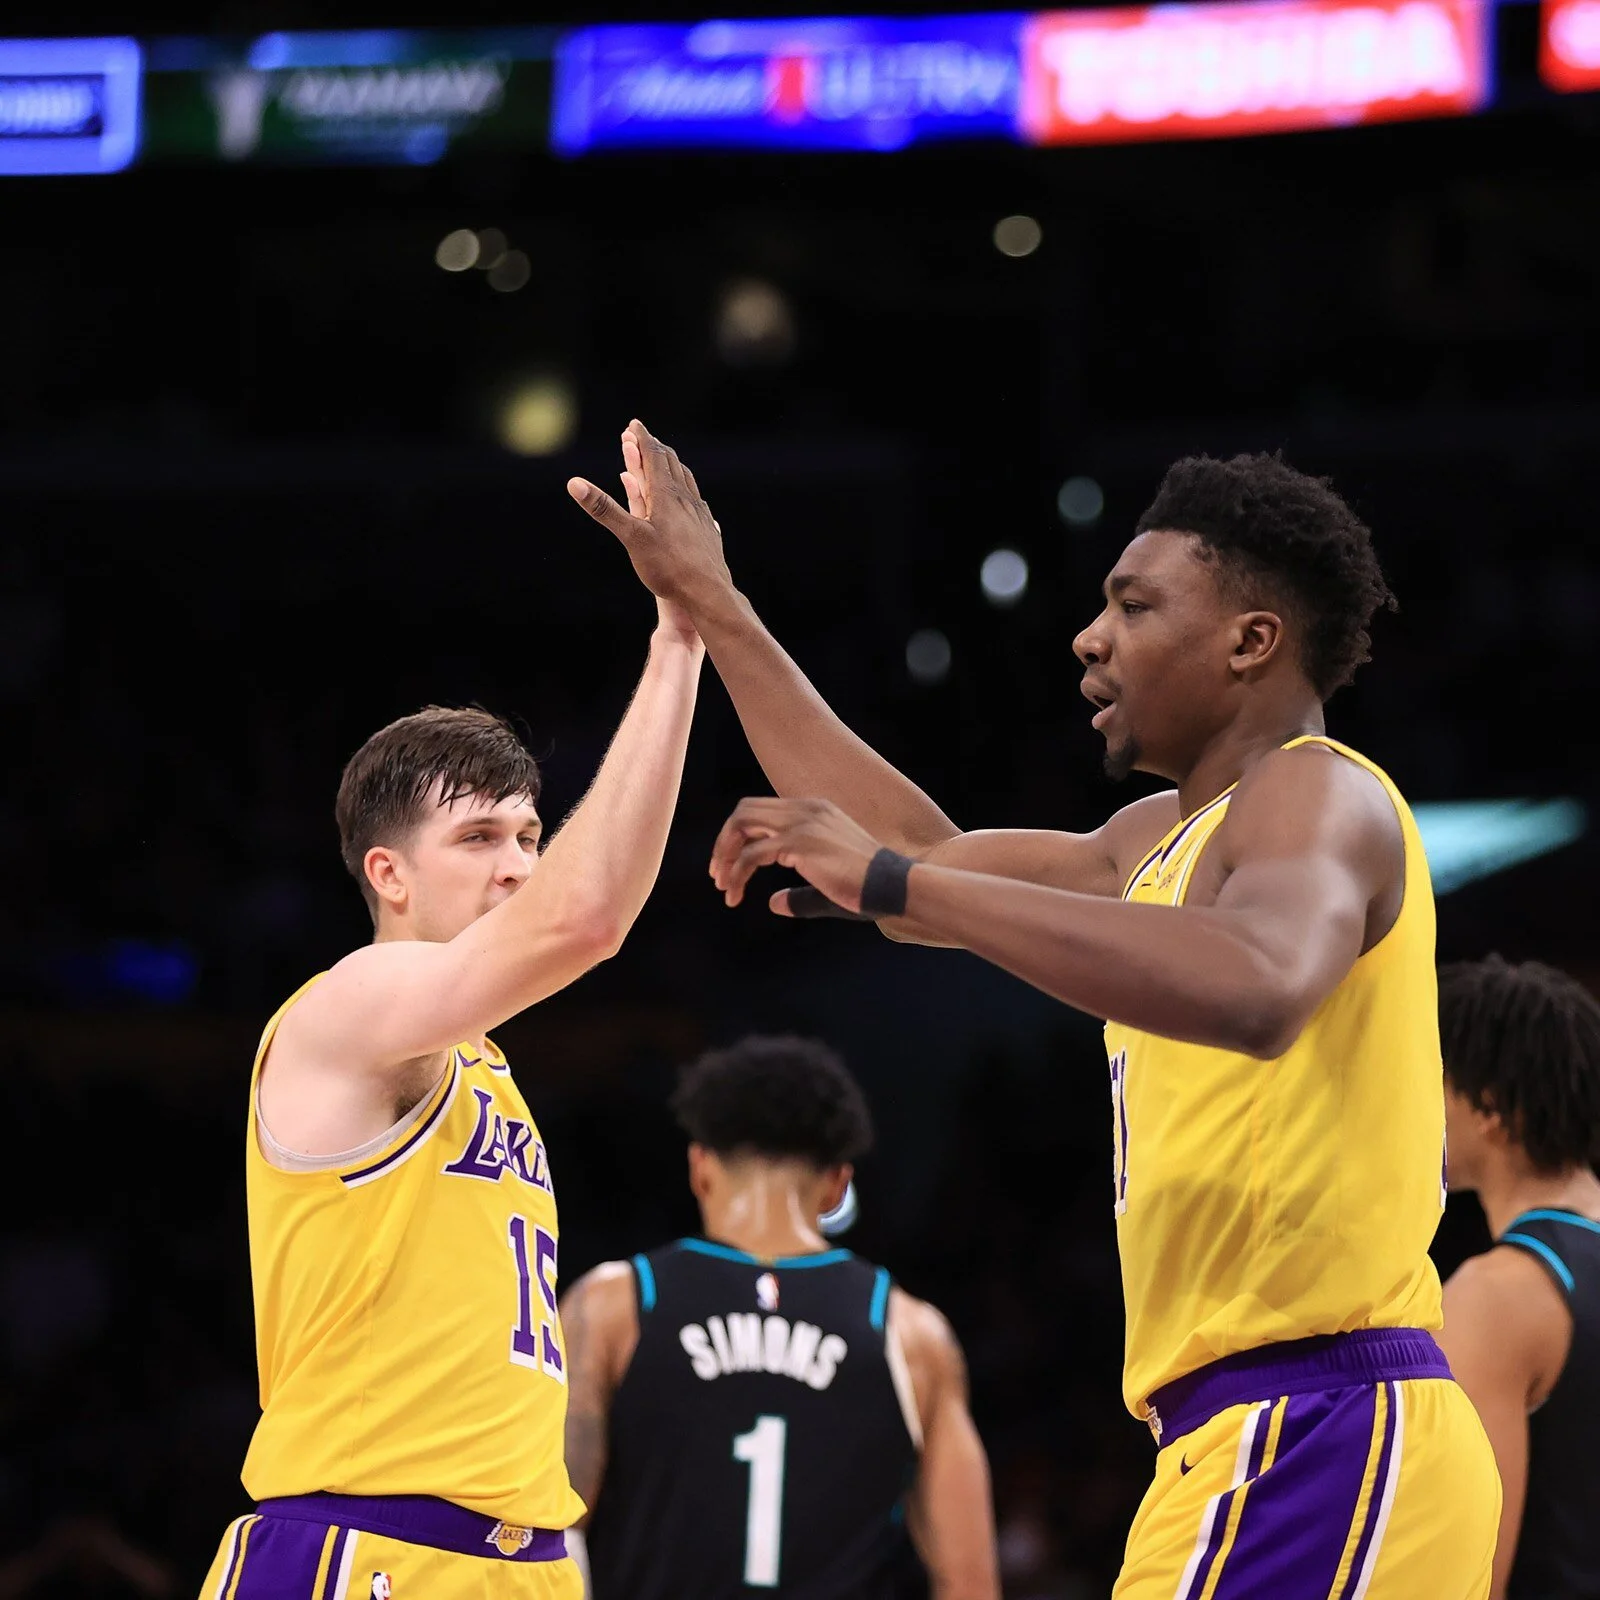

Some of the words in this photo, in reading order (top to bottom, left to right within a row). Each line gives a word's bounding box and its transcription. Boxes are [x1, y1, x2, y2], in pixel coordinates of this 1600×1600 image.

[508, 1212, 565, 1387] 15
[679, 1311, 848, 1391] SIMONS
[732, 1413, 788, 1588] 1
